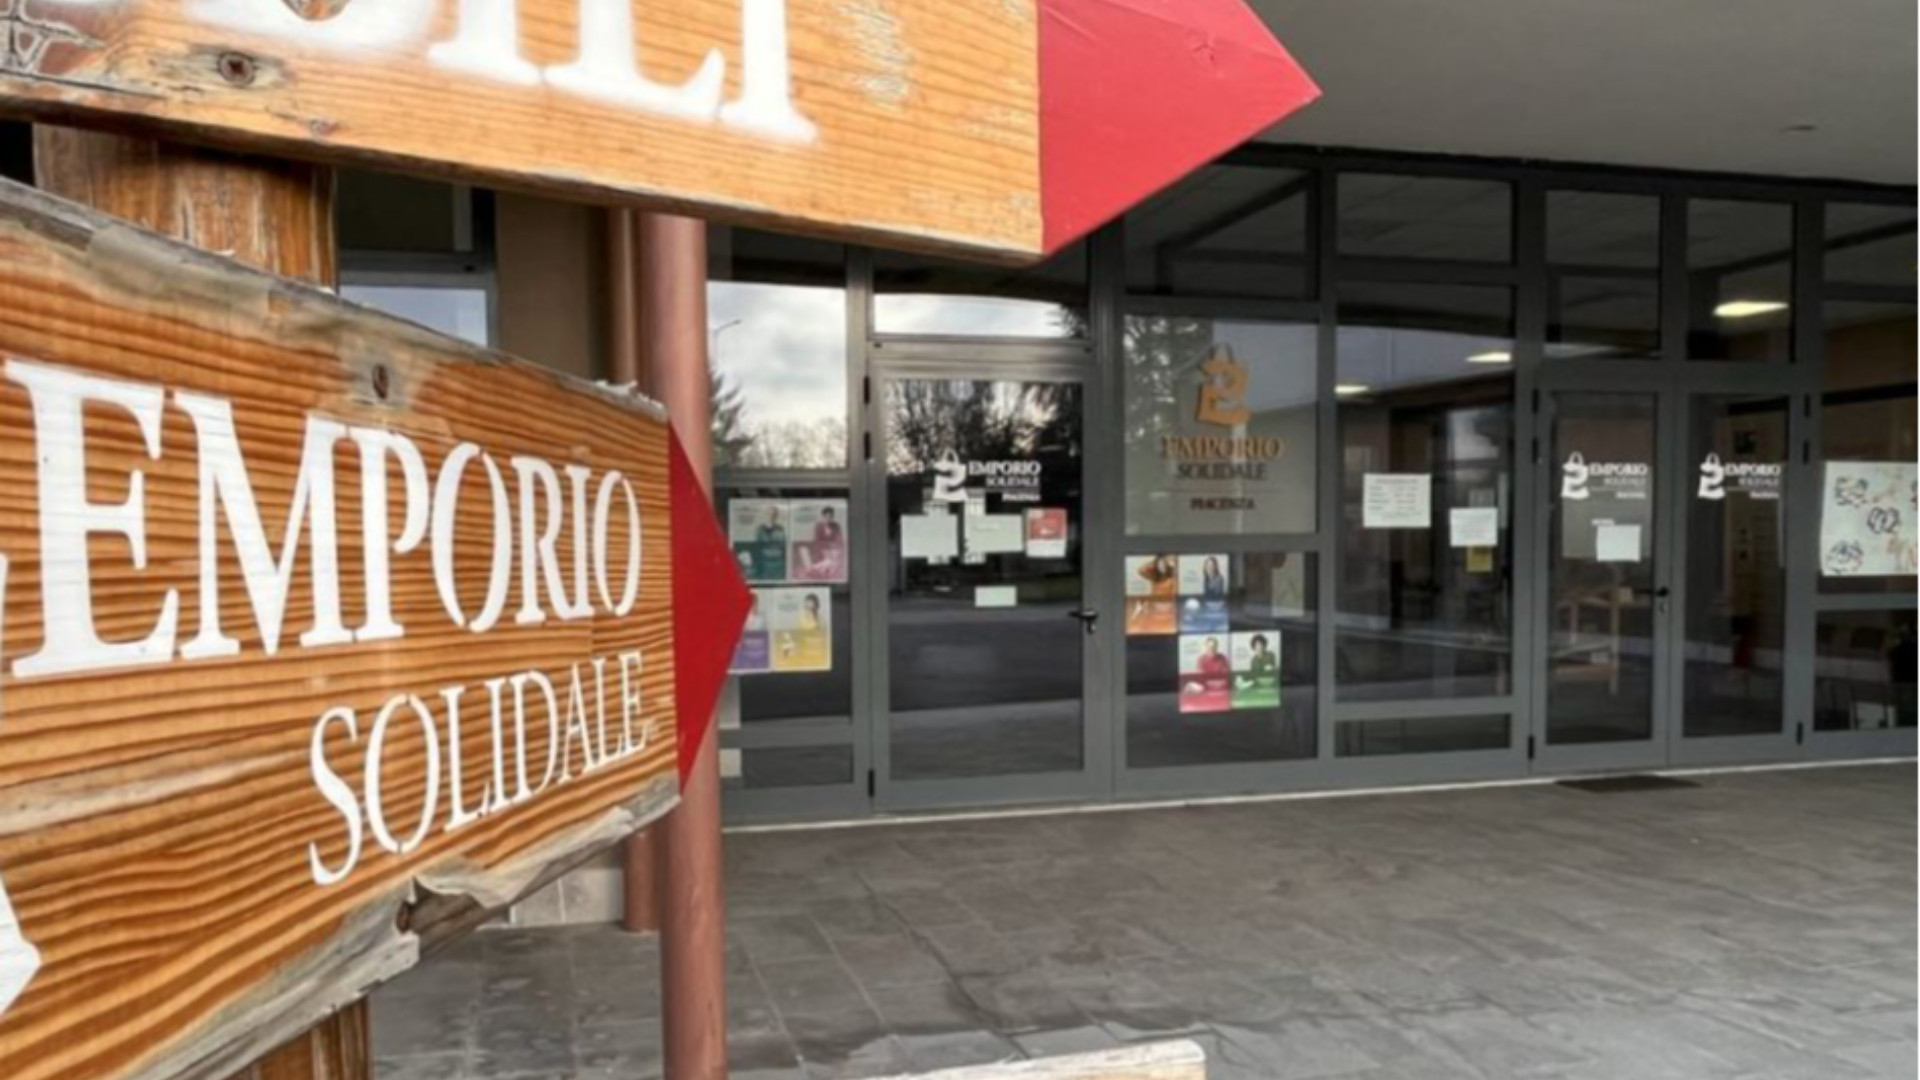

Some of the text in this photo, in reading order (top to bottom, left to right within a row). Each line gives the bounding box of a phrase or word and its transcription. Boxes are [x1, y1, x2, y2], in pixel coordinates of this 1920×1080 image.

[1161, 436, 1281, 460] EMPORIO
[968, 460, 1041, 475] EMPORIO
[1176, 462, 1269, 480] SOLIDALE
[1589, 463, 1648, 476] EMPORIO
[1725, 463, 1781, 476] EMPORIO
[4, 358, 642, 677] EMPORIO
[308, 650, 646, 887] SOLIDALE
